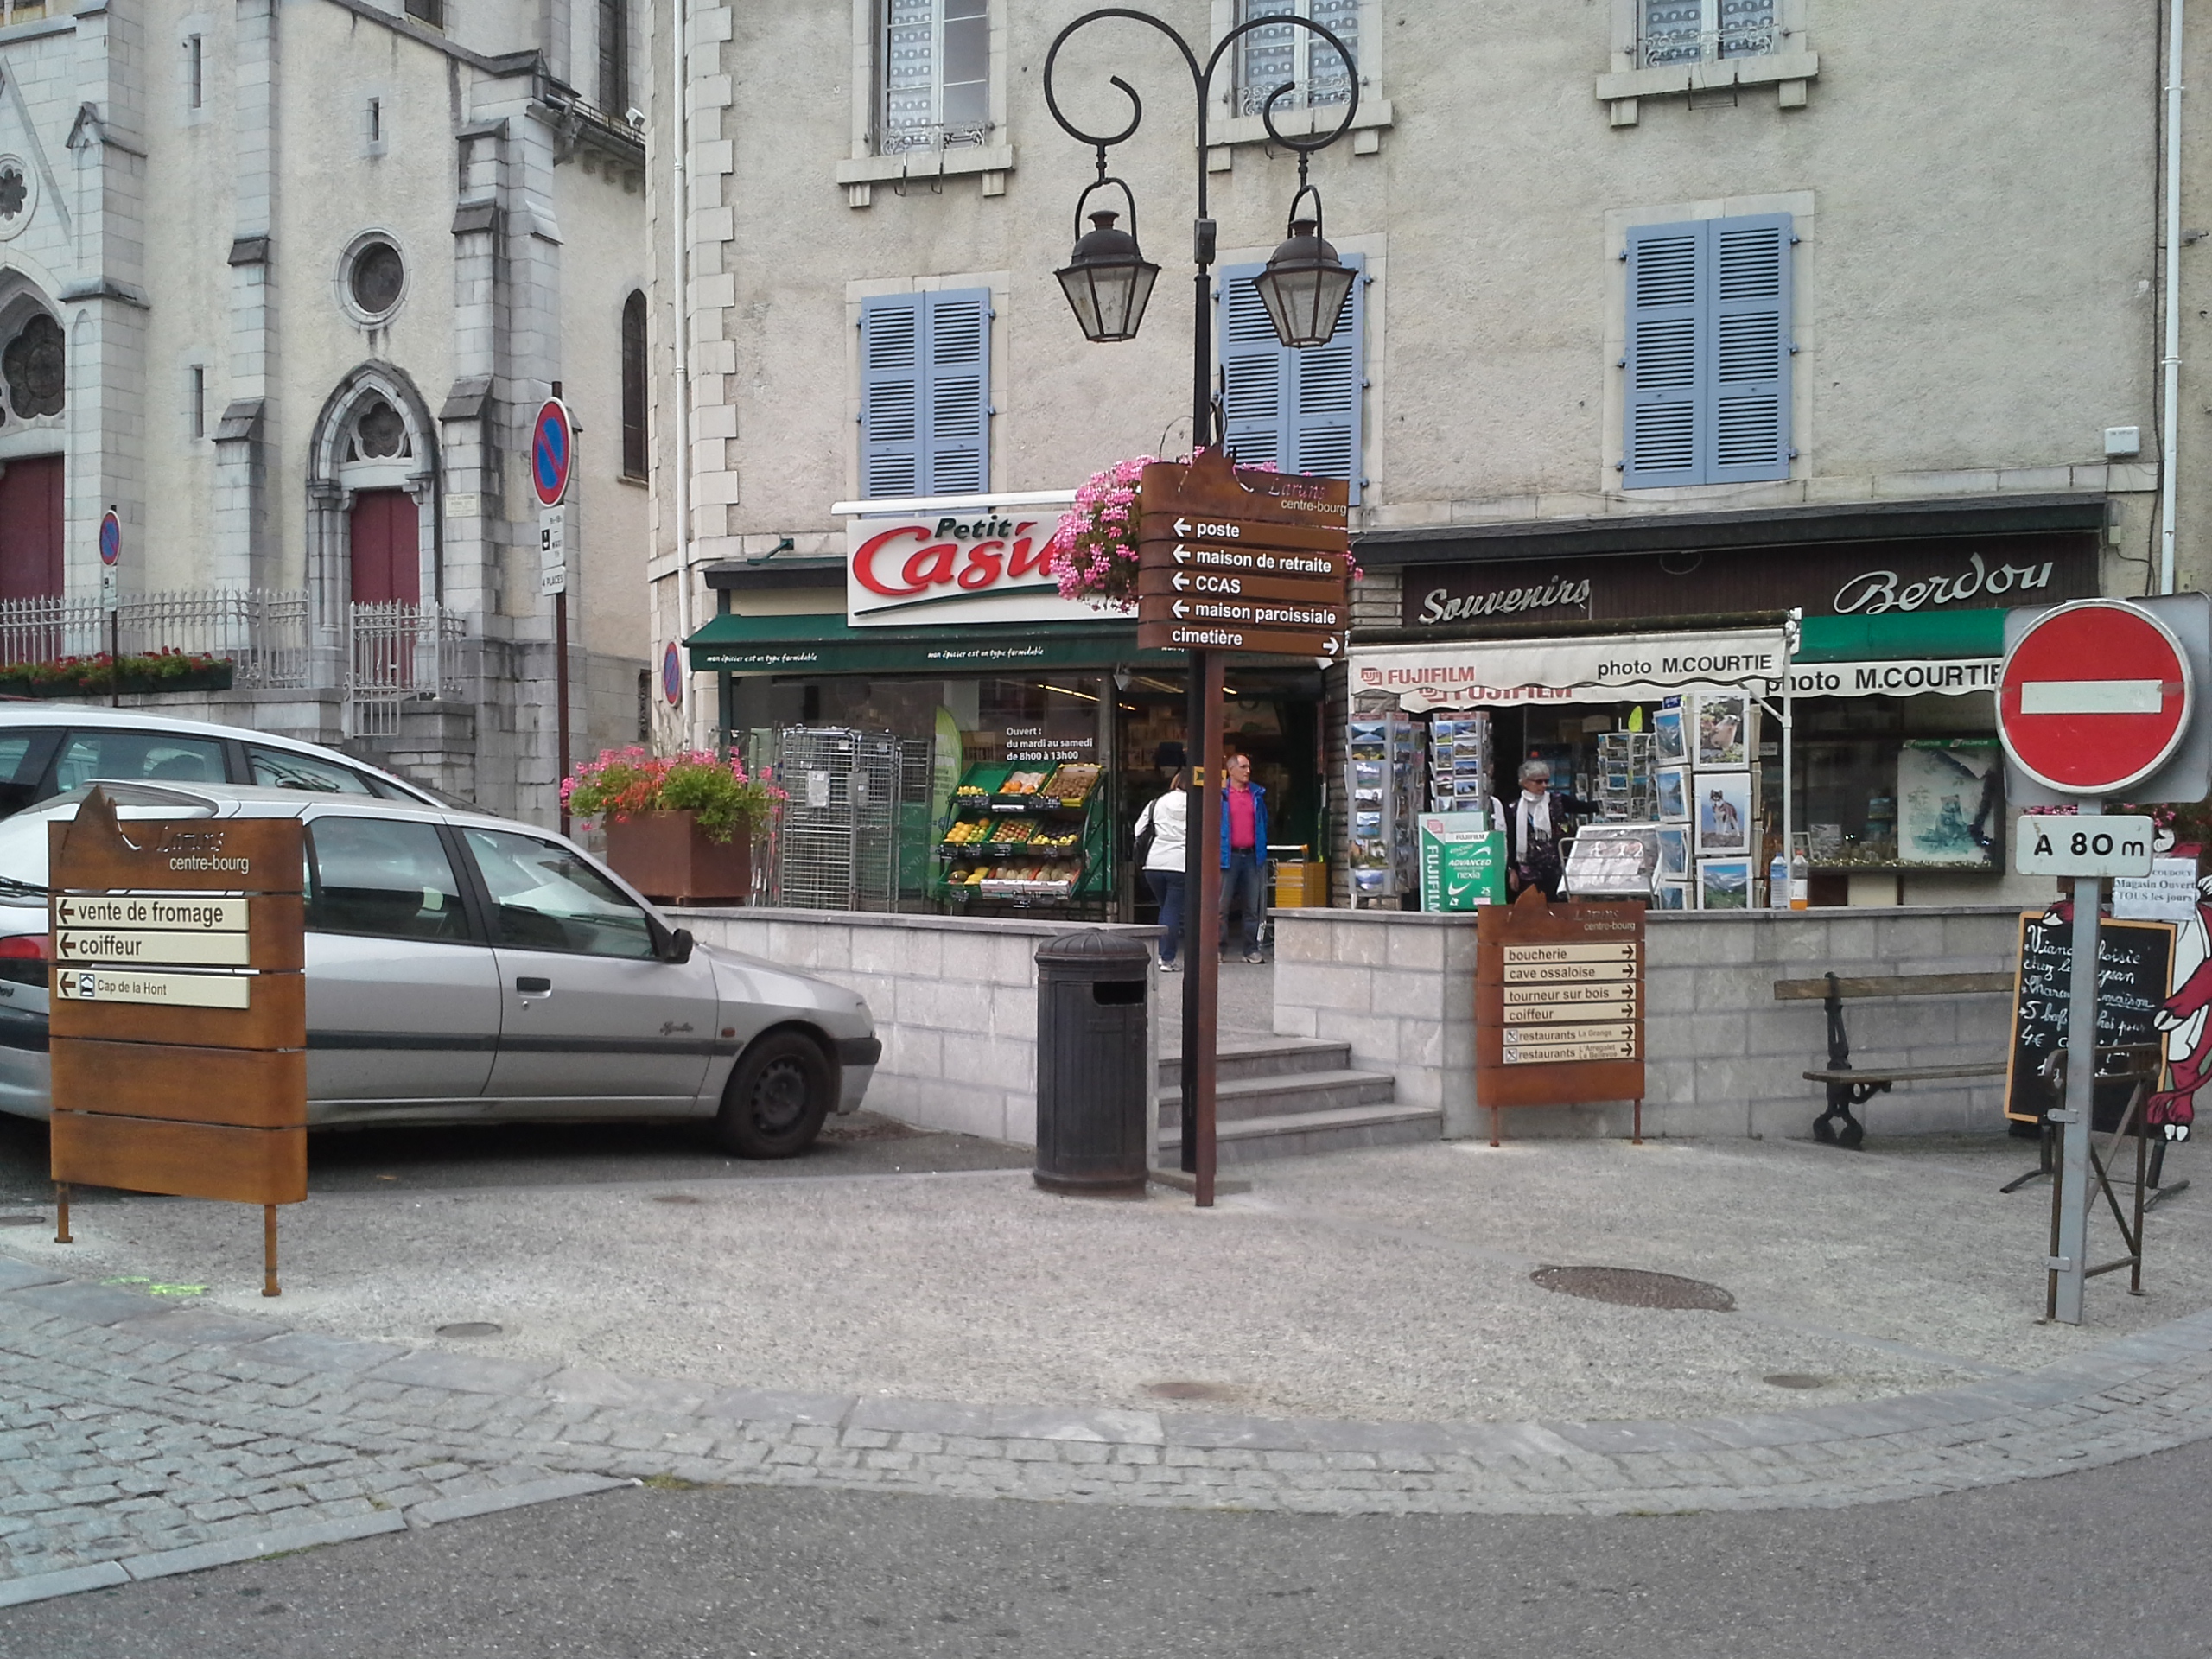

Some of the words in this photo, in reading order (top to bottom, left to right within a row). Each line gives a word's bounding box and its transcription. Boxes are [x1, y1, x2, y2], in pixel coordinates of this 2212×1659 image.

[1268, 477, 1326, 500] Laruns
[1281, 499, 1347, 517] centre-bourg
[934, 514, 1012, 540] Petit
[1197, 522, 1240, 538] poste
[1196, 550, 1252, 567] maison
[1256, 553, 1274, 569] de
[1279, 554, 1332, 573] retraite
[1195, 575, 1241, 594] CCAS
[1834, 552, 2053, 615] Berdou
[1418, 575, 1590, 626] Souvenirs
[1195, 602, 1251, 620] maison
[1255, 607, 1336, 625] paroissiale
[1172, 626, 1243, 645] cimetière
[766, 655, 780, 664] type
[989, 649, 1006, 659] type
[1007, 645, 1044, 658] formidable
[1598, 659, 1651, 679] photo
[1662, 654, 1772, 673] M.COURTIE
[1388, 666, 1475, 684] FUJIFILM
[1006, 727, 1037, 735] Ouvert
[1006, 740, 1018, 748] du
[1020, 739, 1046, 748] mardi
[1060, 737, 1093, 747] samedi
[1007, 752, 1018, 760] de
[1020, 752, 1042, 760] 8h00
[1043, 751, 1049, 760] à
[1051, 750, 1078, 760] 13h00
[2070, 833, 2113, 856] 80
[2121, 837, 2145, 857] m
[169, 854, 250, 874] centre-bourg
[1427, 845, 1440, 912] FUJIFILM
[1457, 869, 1481, 879] nexia
[2116, 879, 2157, 889] Magasin
[2159, 880, 2196, 889] Ouvert
[2119, 891, 2148, 900] TOUS
[2151, 892, 2164, 901] les
[2166, 893, 2194, 903] jours
[78, 904, 122, 921] vente
[127, 901, 147, 922] de
[152, 901, 224, 927] fromage
[1584, 920, 1636, 931] centre-bourg
[79, 934, 142, 956] coiffeur
[1509, 948, 1567, 962] boucherie
[1510, 969, 1536, 979] cave
[1541, 966, 1596, 978] ossaloise
[98, 979, 116, 993] Cap
[118, 980, 130, 993] de
[132, 981, 141, 994] la
[143, 982, 167, 995] Hont
[1509, 989, 1560, 1002] tourneur
[1562, 990, 1582, 1000] sur
[1585, 987, 1610, 998] bois
[1509, 1008, 1554, 1021] coiffeur
[1518, 1030, 1576, 1042] restaurants
[1518, 1048, 1575, 1060] restaurants
